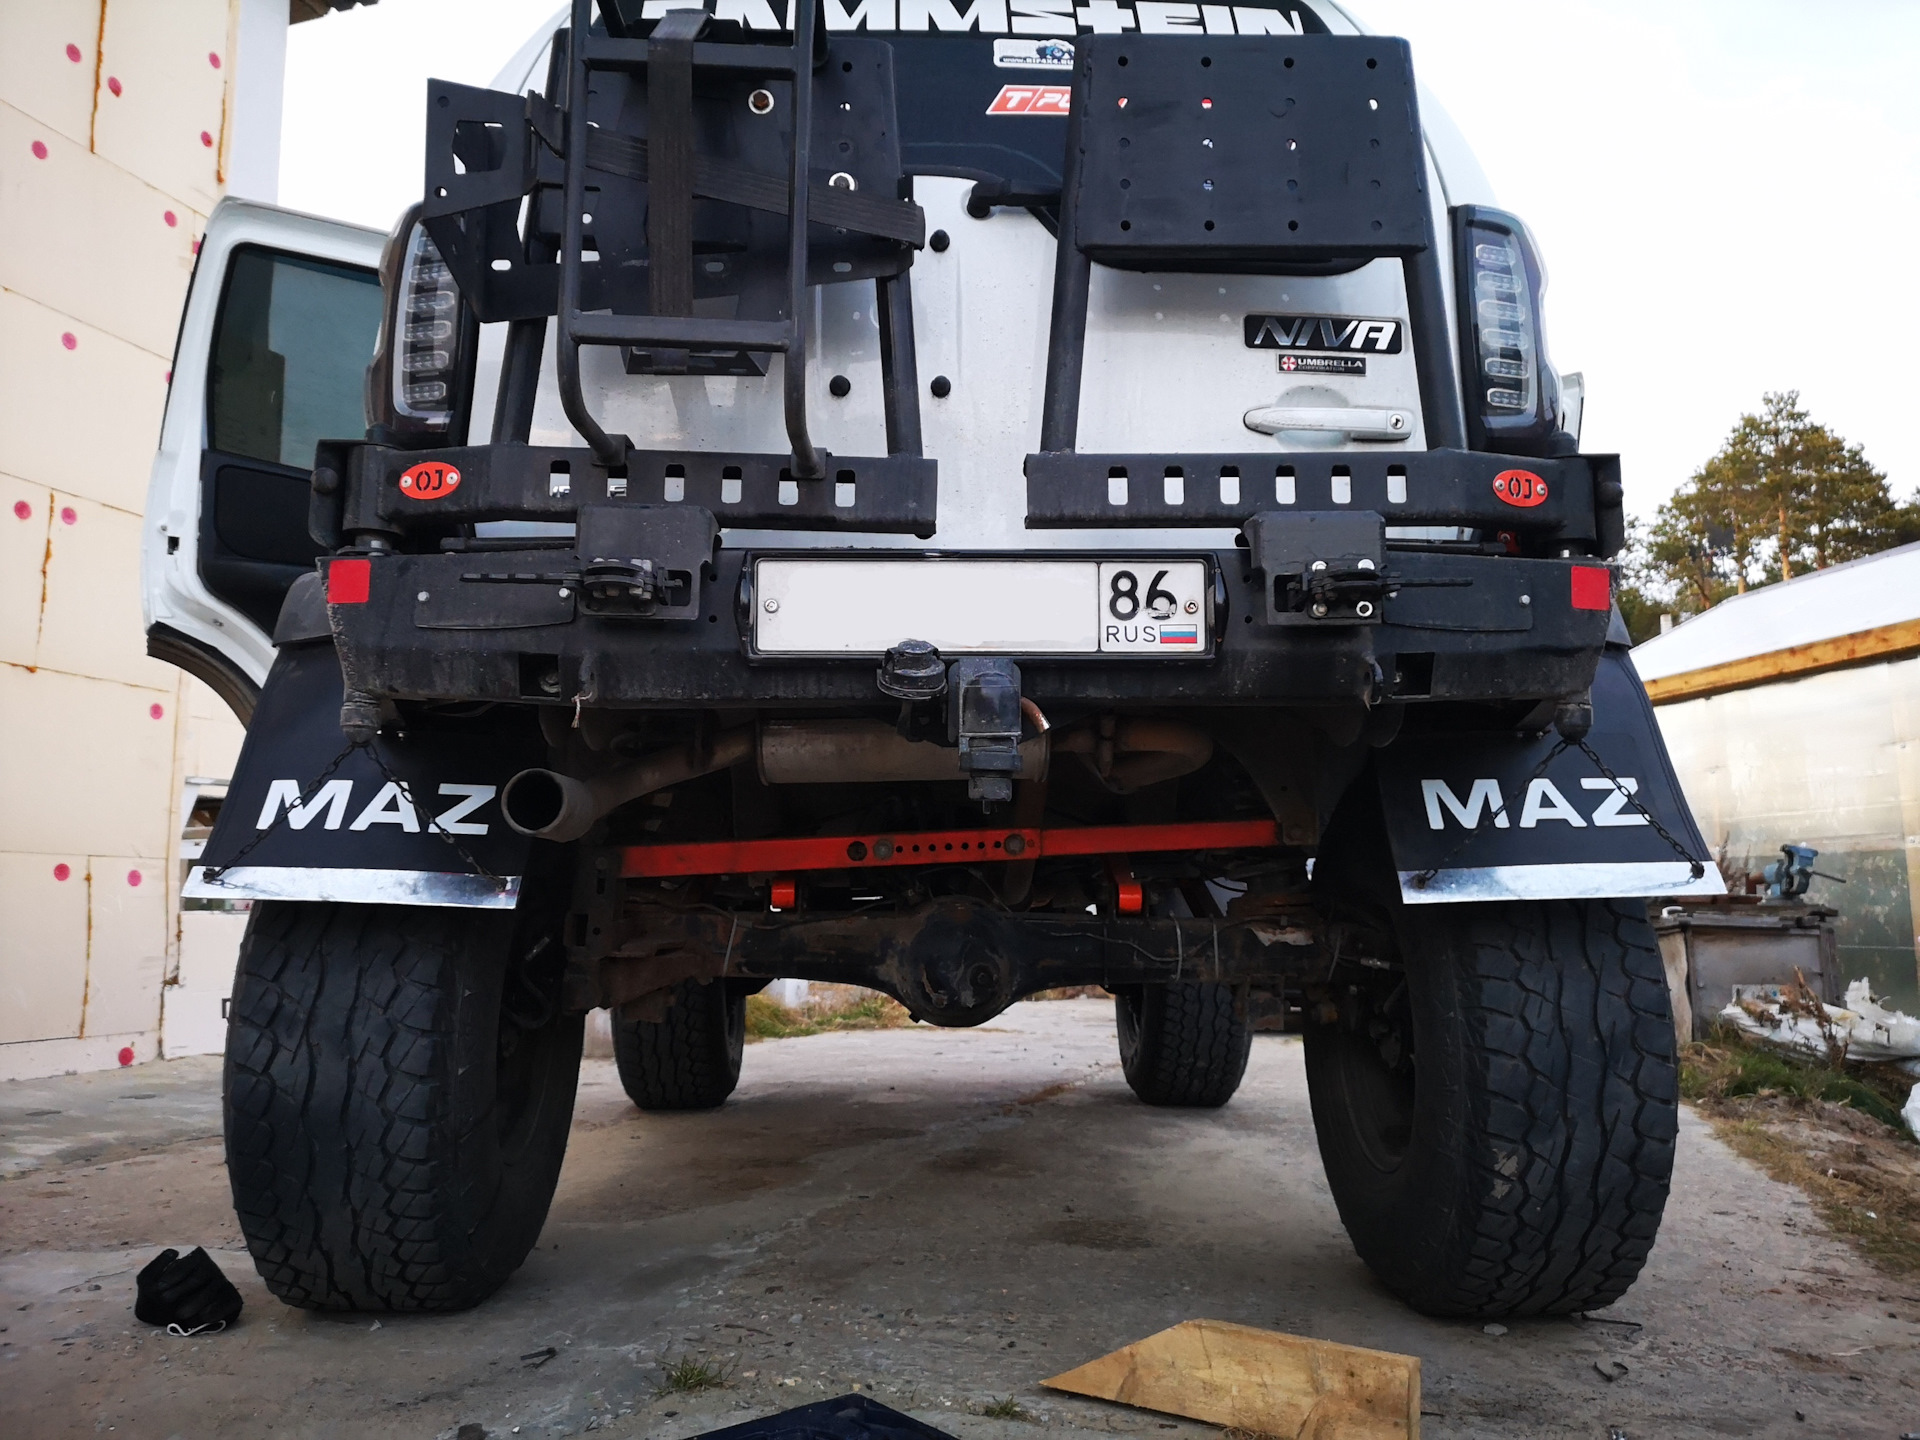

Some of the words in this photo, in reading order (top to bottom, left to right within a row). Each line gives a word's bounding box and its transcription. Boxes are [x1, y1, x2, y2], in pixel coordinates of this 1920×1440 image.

[1254, 318, 1396, 350] NIVA
[1298, 358, 1363, 367] UMBRELLA
[1109, 570, 1177, 621] 86
[1106, 625, 1156, 643] RUS
[256, 779, 497, 835] MAZ
[1420, 777, 1650, 830] MAZ
